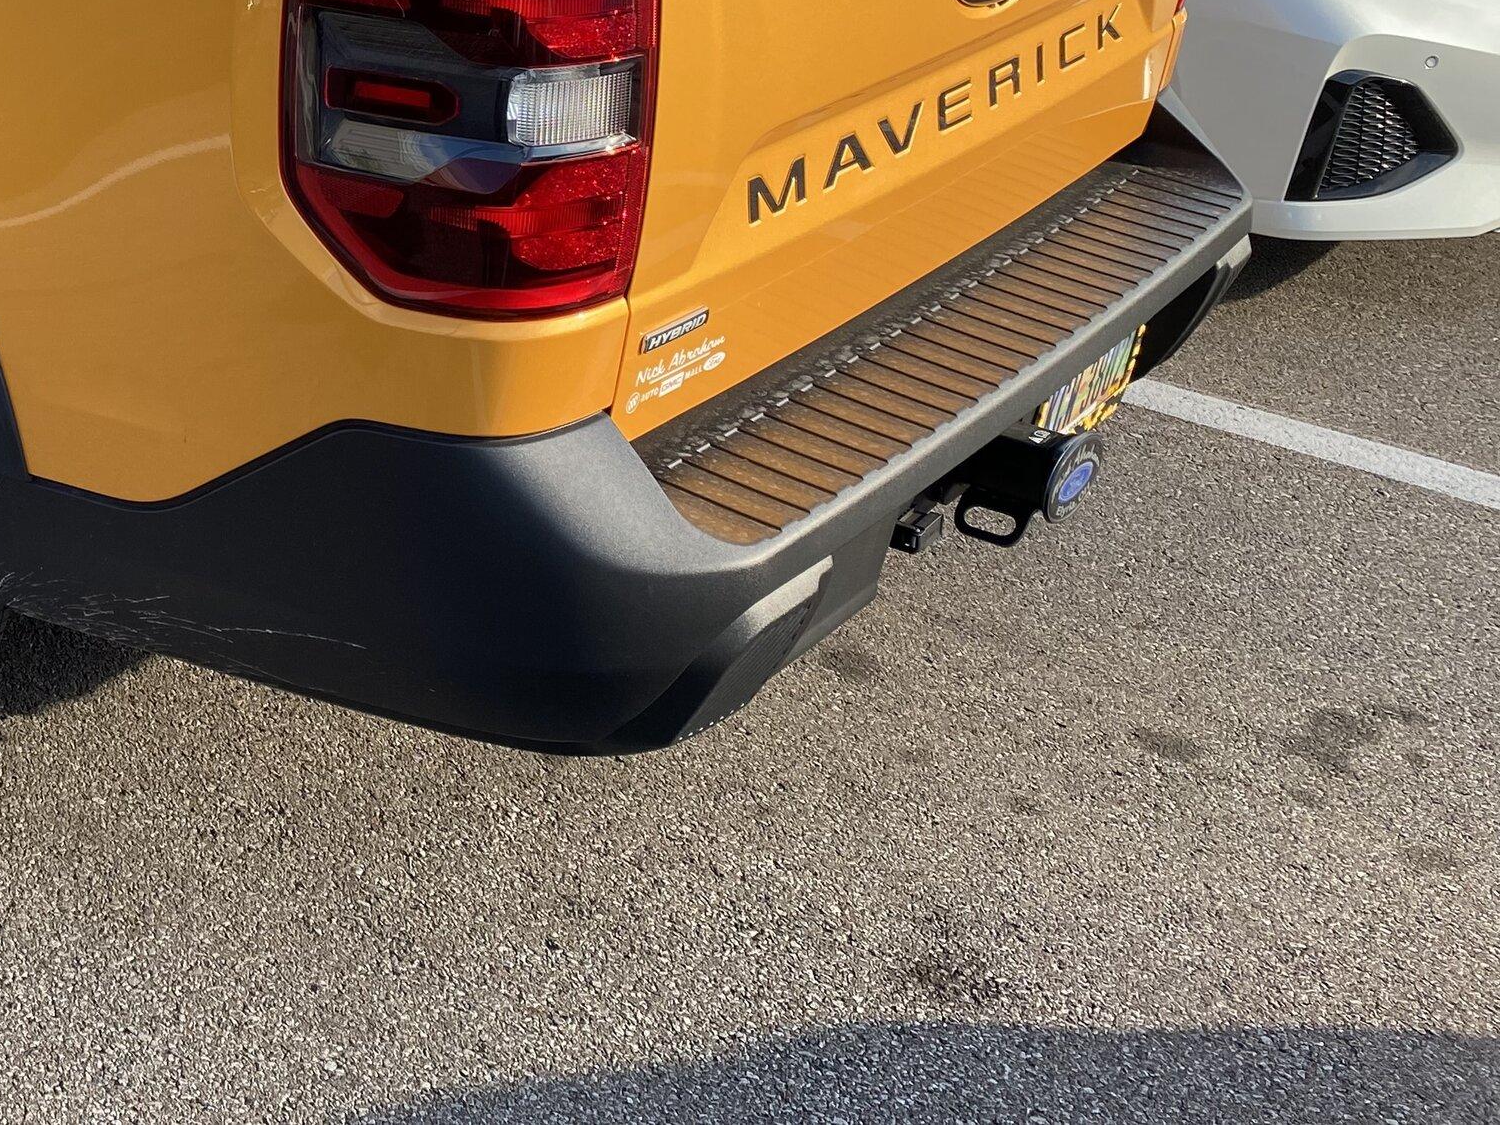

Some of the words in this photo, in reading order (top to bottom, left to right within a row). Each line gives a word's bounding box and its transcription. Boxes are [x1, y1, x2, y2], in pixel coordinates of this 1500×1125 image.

[747, 3, 1124, 227] MAVERICK
[649, 313, 708, 350] HYBRID
[636, 359, 666, 387] Nick
[669, 336, 726, 371] Abraham
[640, 387, 660, 402] AUTO
[661, 374, 682, 394] GMC
[684, 365, 703, 381] MALL
